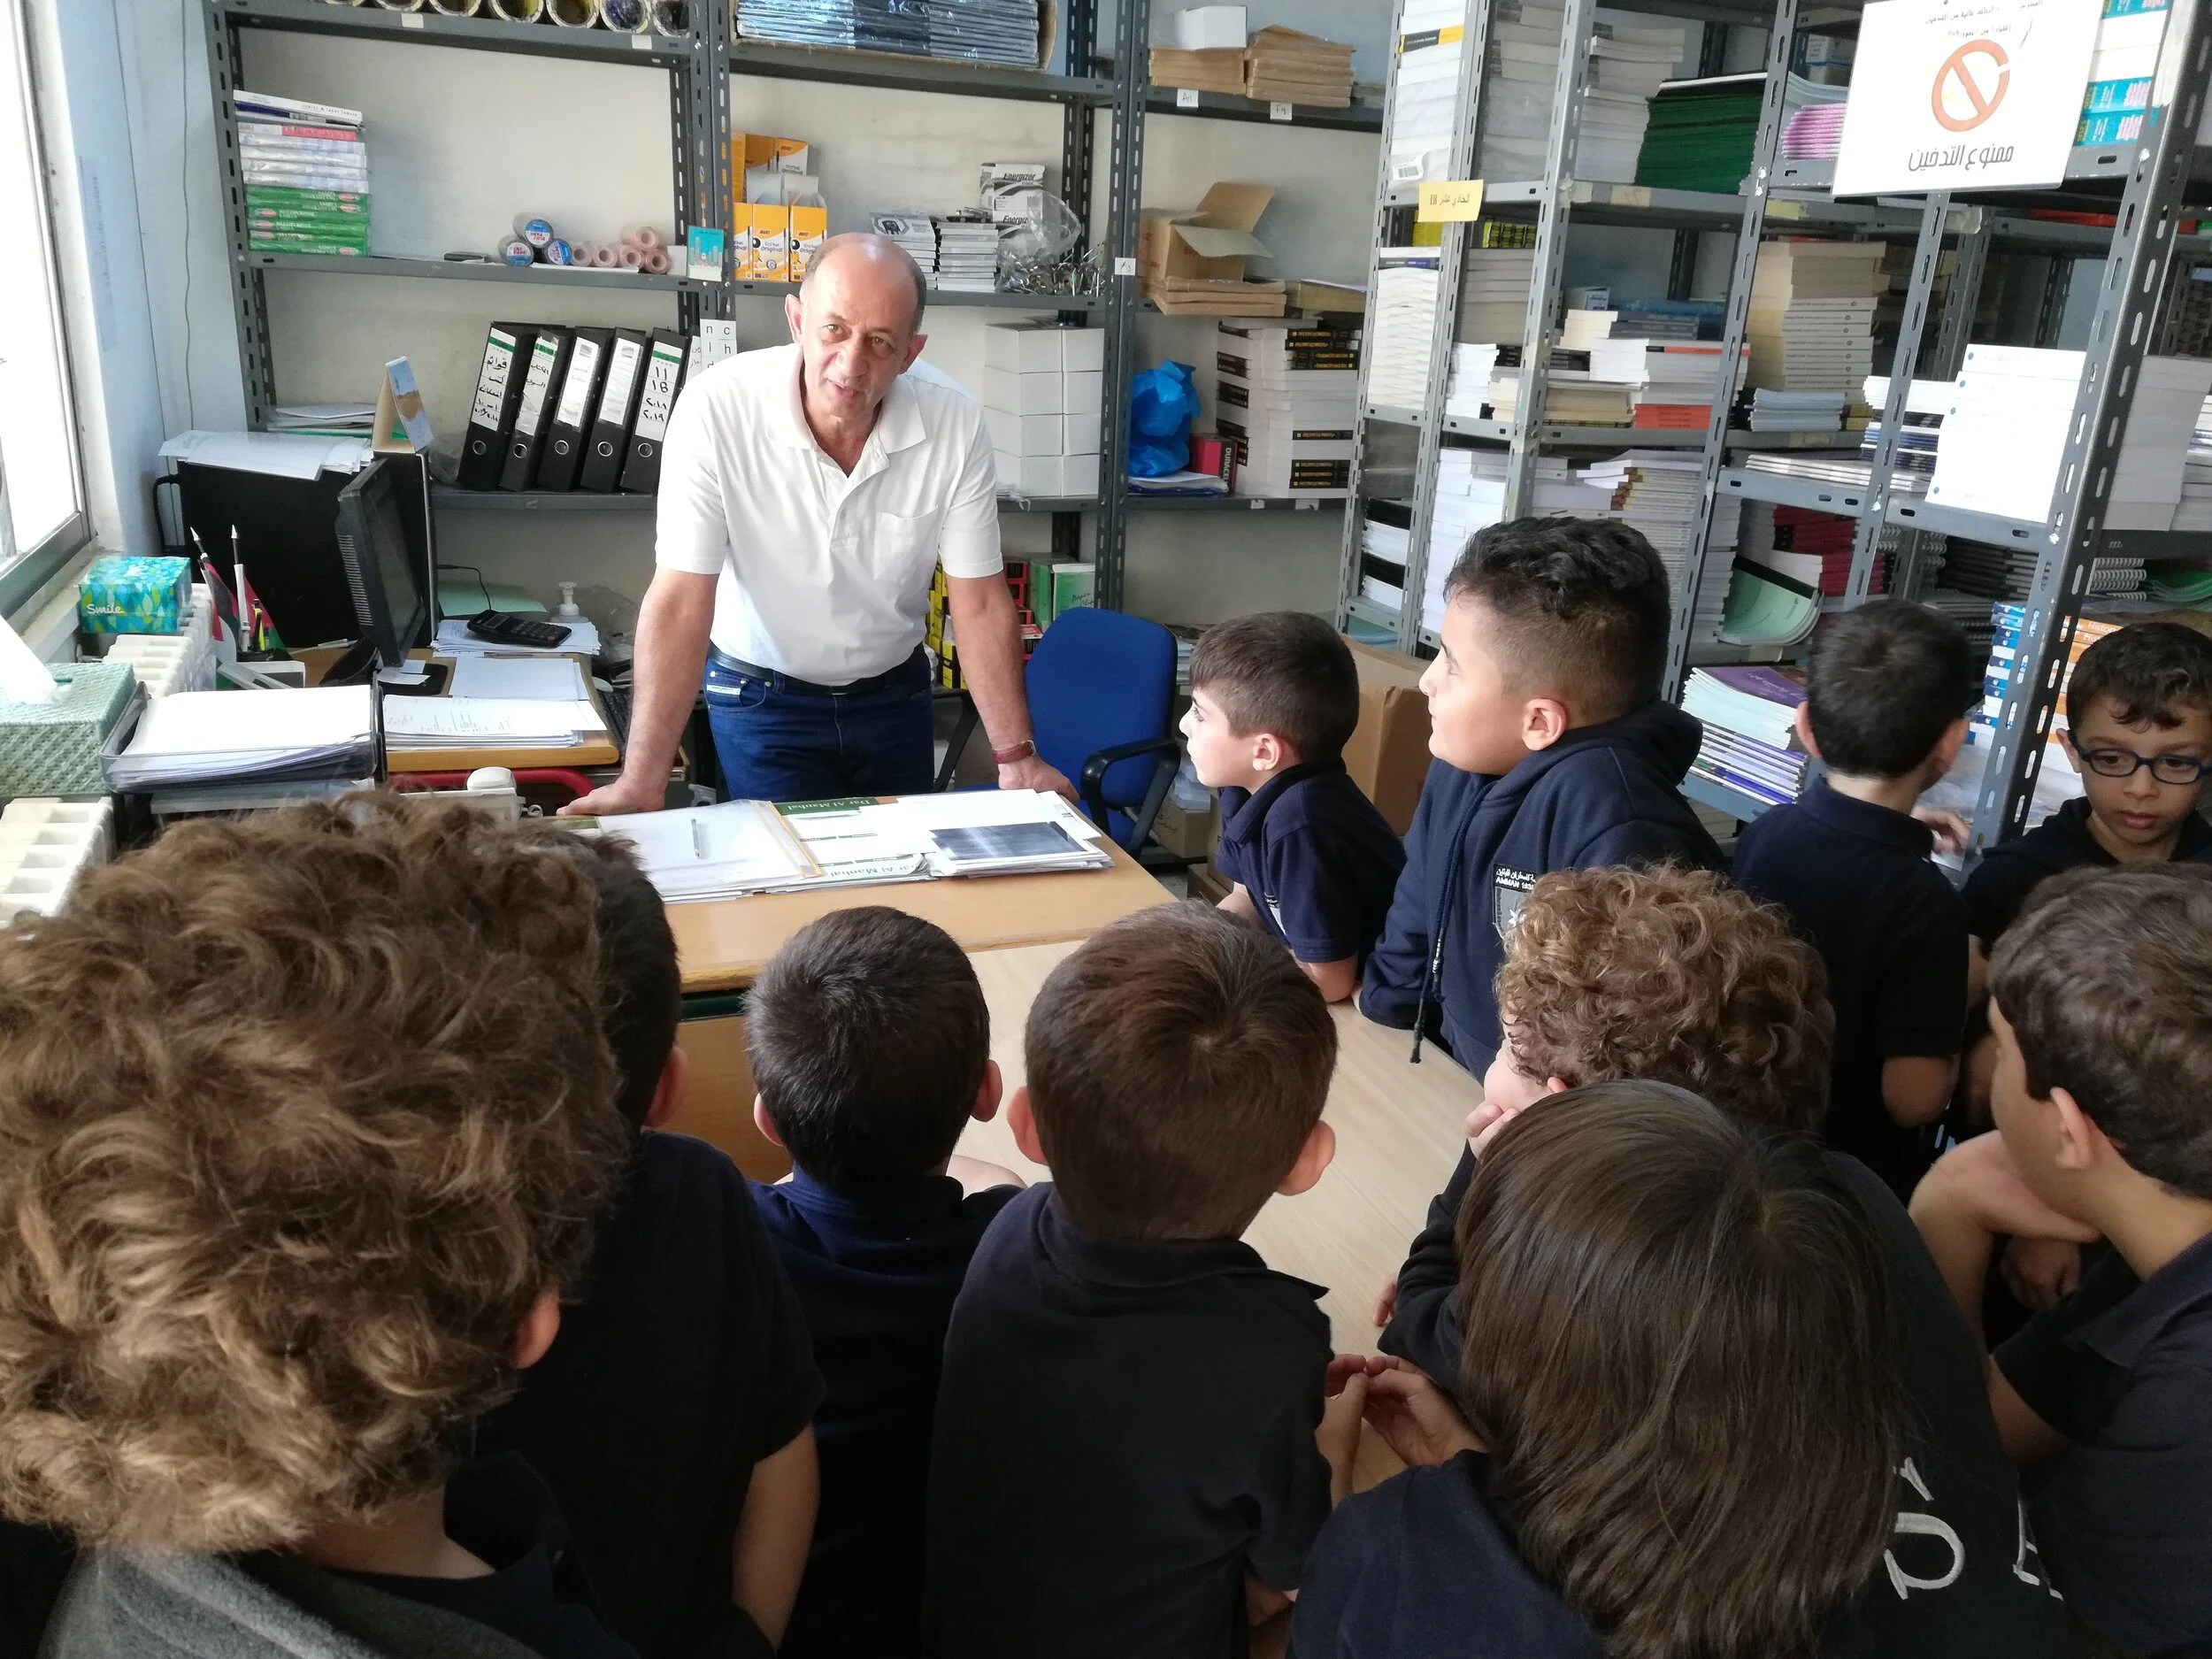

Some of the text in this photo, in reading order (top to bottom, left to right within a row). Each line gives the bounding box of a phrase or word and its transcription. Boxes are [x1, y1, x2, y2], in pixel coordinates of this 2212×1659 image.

[1908, 143, 2015, 173] ممنوع التدخين
[1002, 173, 1036, 182] Energizer
[1002, 215, 1029, 226] Energiz
[87, 603, 126, 614] Smile
[831, 866, 878, 878] Manhal
[1495, 876, 1520, 888] AMMAN
